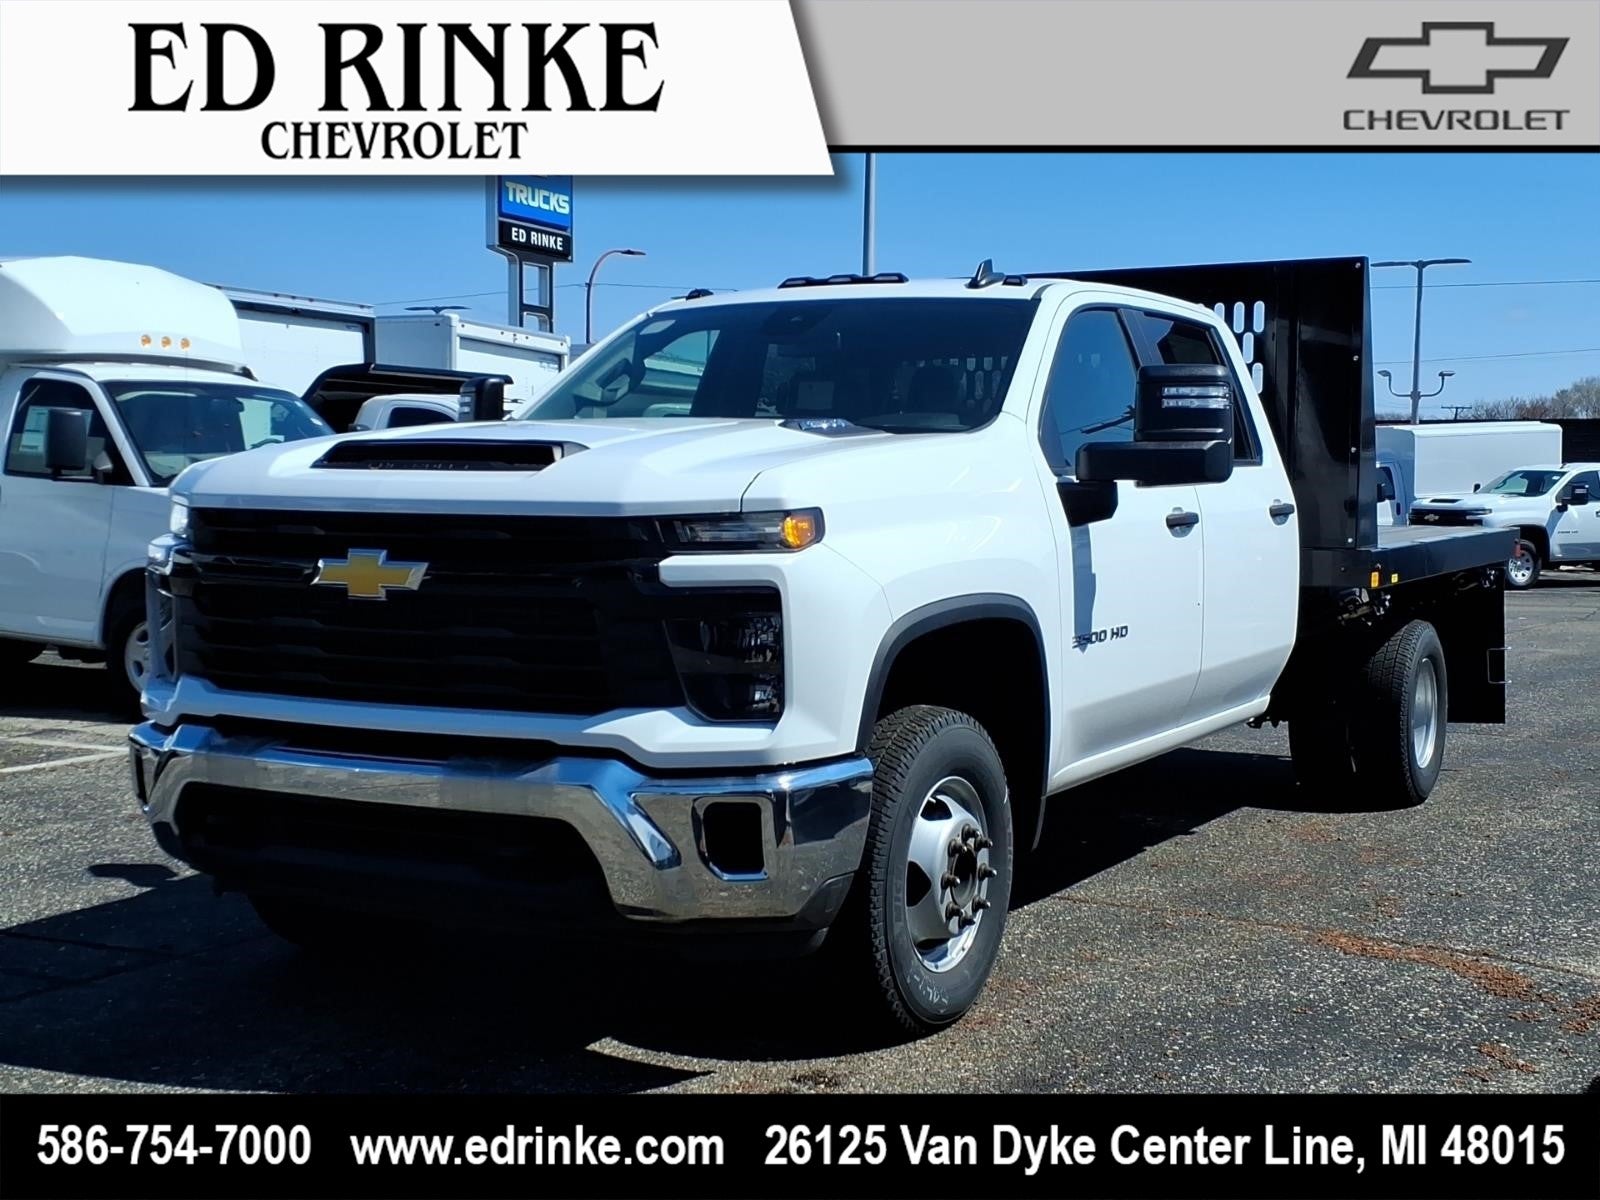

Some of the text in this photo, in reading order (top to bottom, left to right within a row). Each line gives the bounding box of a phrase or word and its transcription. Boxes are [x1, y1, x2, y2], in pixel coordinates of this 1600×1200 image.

[505, 181, 570, 215] TRUCKS
[511, 227, 564, 251] ED RINKE
[1110, 625, 1129, 641] HD
